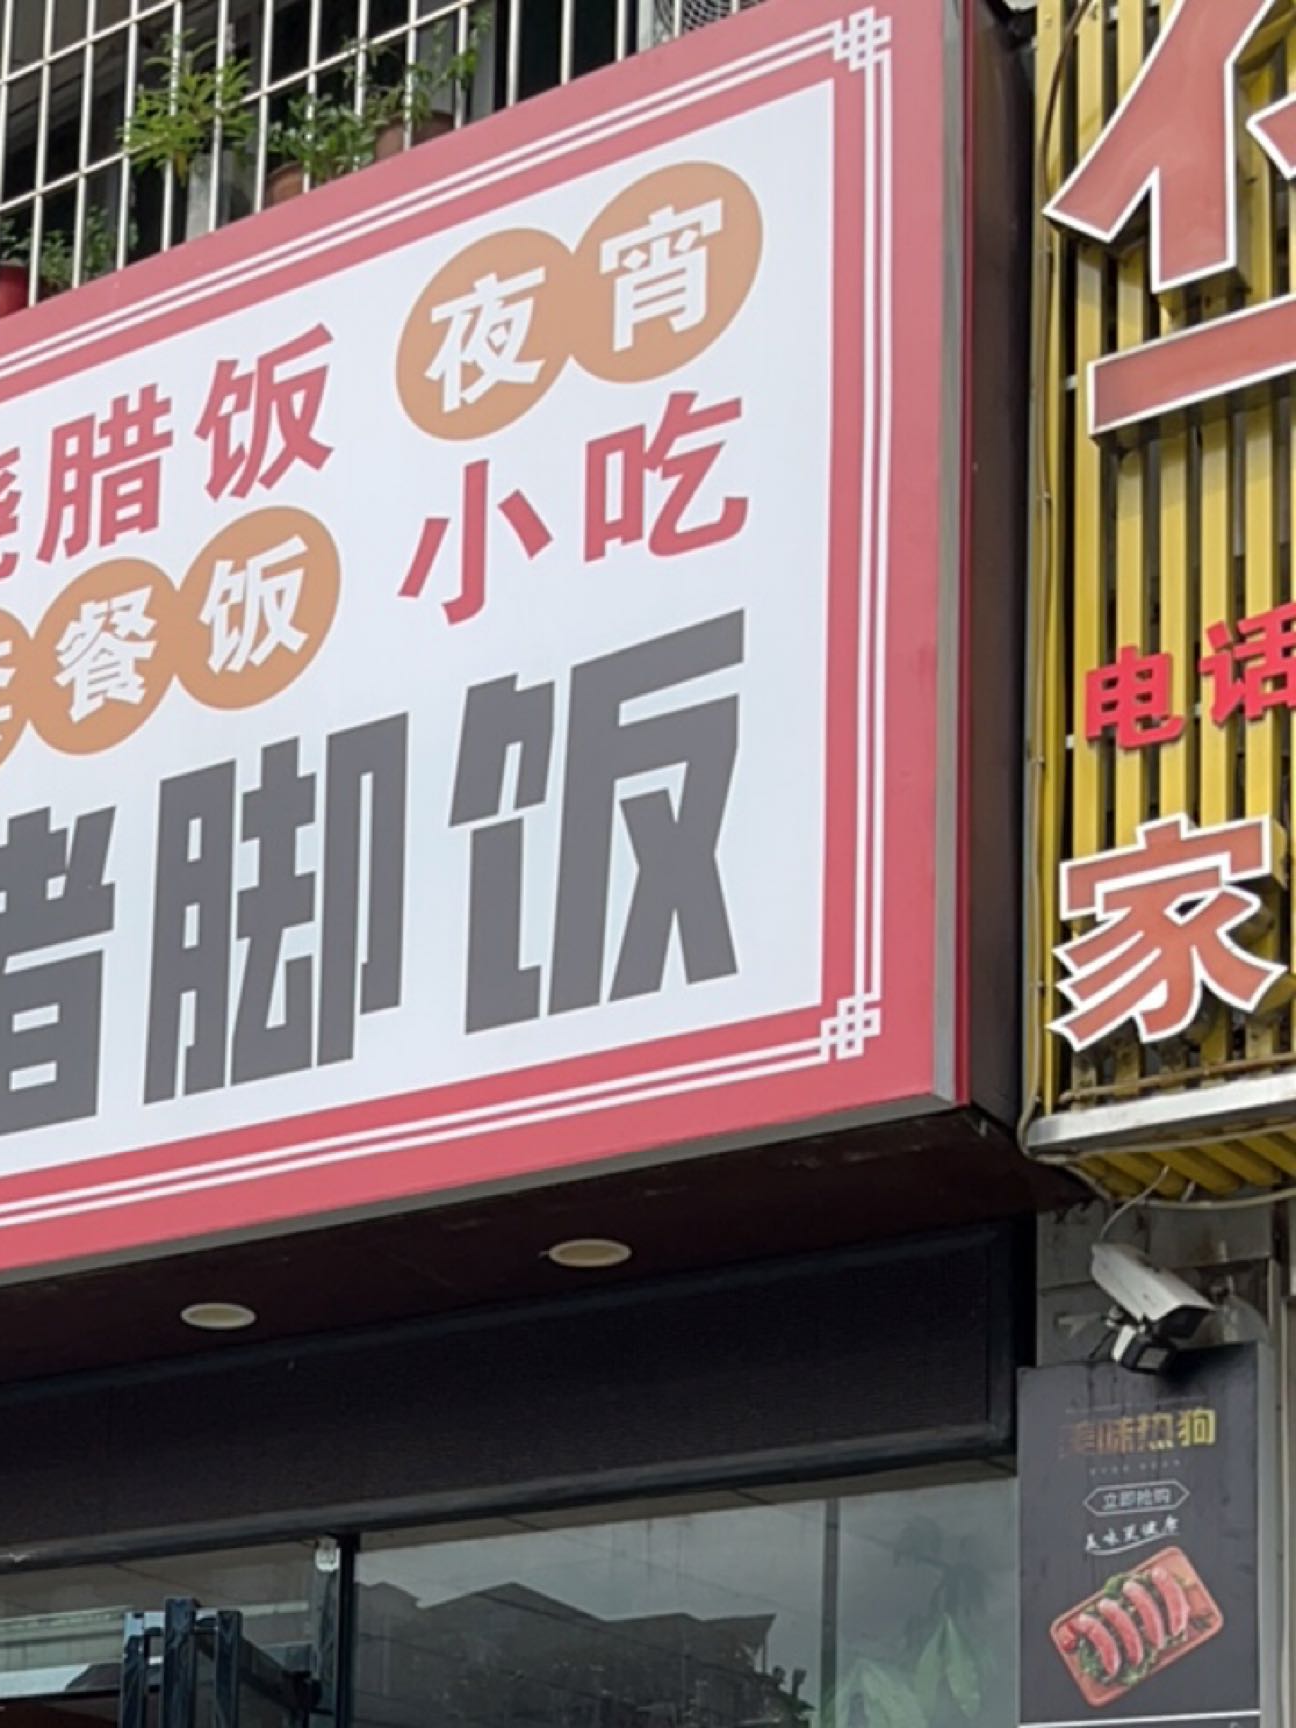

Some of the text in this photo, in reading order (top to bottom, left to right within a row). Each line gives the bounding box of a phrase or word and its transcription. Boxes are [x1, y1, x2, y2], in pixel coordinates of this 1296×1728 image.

[423, 198, 725, 412] 夜宵
[398, 391, 749, 624] 小吃
[1085, 600, 1296, 749] 电话
[1045, 812, 1286, 1052] 家
